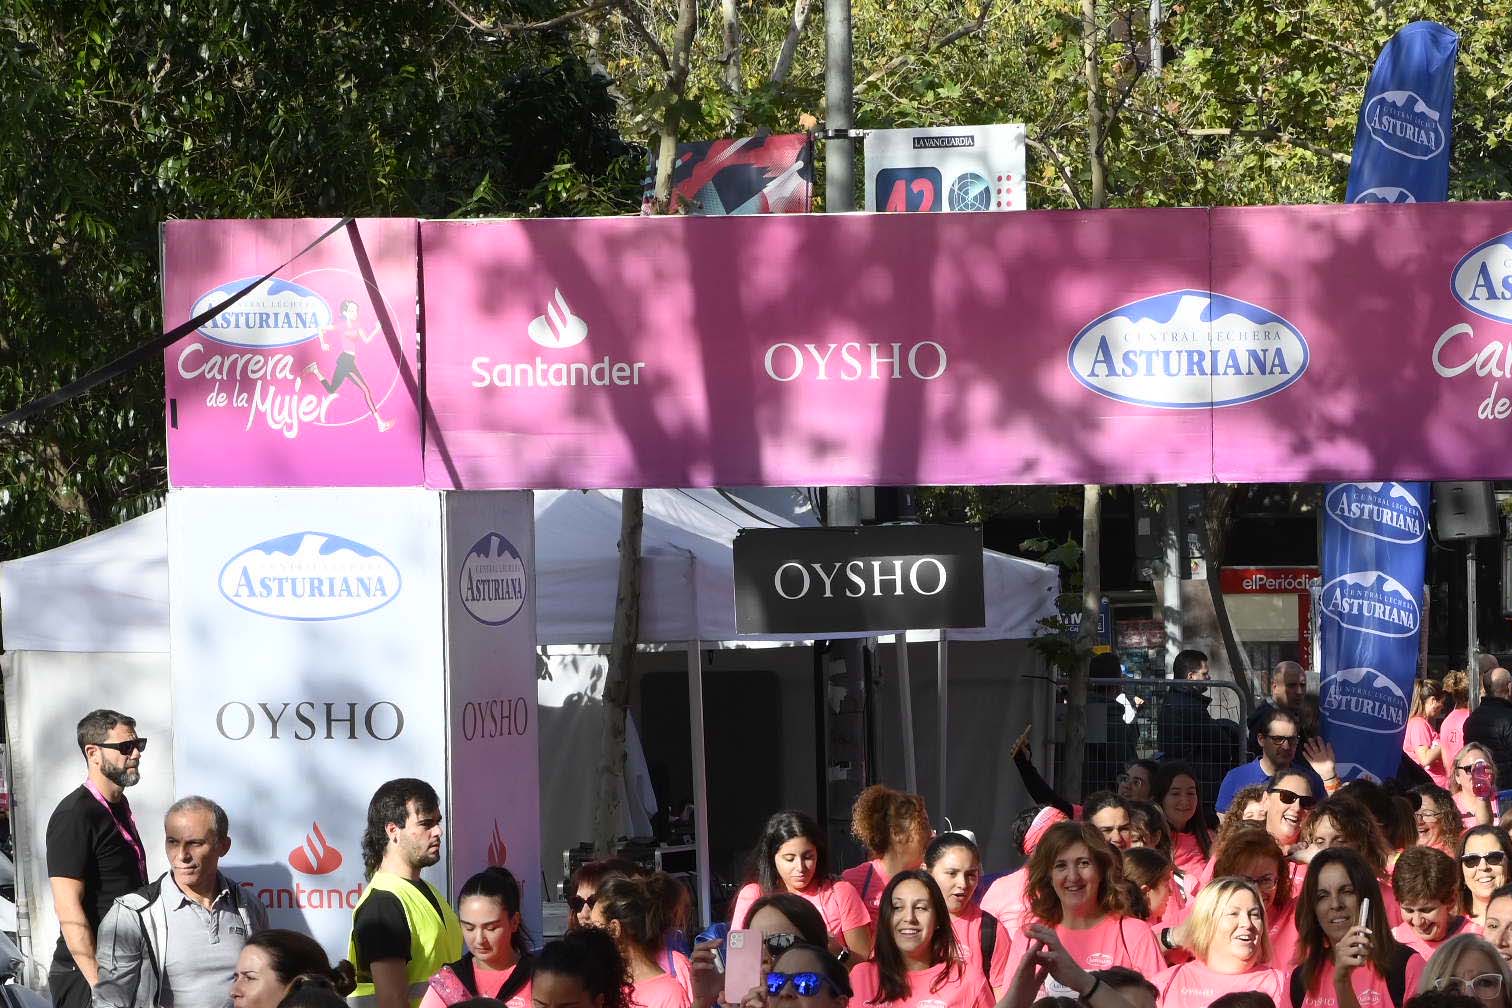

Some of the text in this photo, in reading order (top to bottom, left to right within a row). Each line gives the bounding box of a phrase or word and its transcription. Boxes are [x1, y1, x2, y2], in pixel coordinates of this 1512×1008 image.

[925, 136, 973, 148] VANGUARDIA
[1123, 328, 1282, 344] CENTRAL LECHERA
[178, 343, 294, 380] Carrera
[471, 356, 645, 389] Santander
[764, 340, 948, 383] OYSHO
[1087, 334, 1290, 379] ASTURIANA
[207, 377, 340, 439] de la Mujer
[1478, 380, 1511, 421] de
[1336, 492, 1421, 536] ASTURIANA
[1353, 493, 1390, 506] CENTRAL
[233, 565, 388, 599] ASTURIANA
[465, 566, 524, 602] ASTURIANA
[774, 558, 947, 600] OYSHO
[1343, 589, 1382, 601] CENTRAL
[1328, 588, 1414, 629] ASTURIANA
[216, 701, 405, 741] OYSHO
[462, 696, 529, 742] OYSHO
[1325, 684, 1403, 725] ASTURIANA
